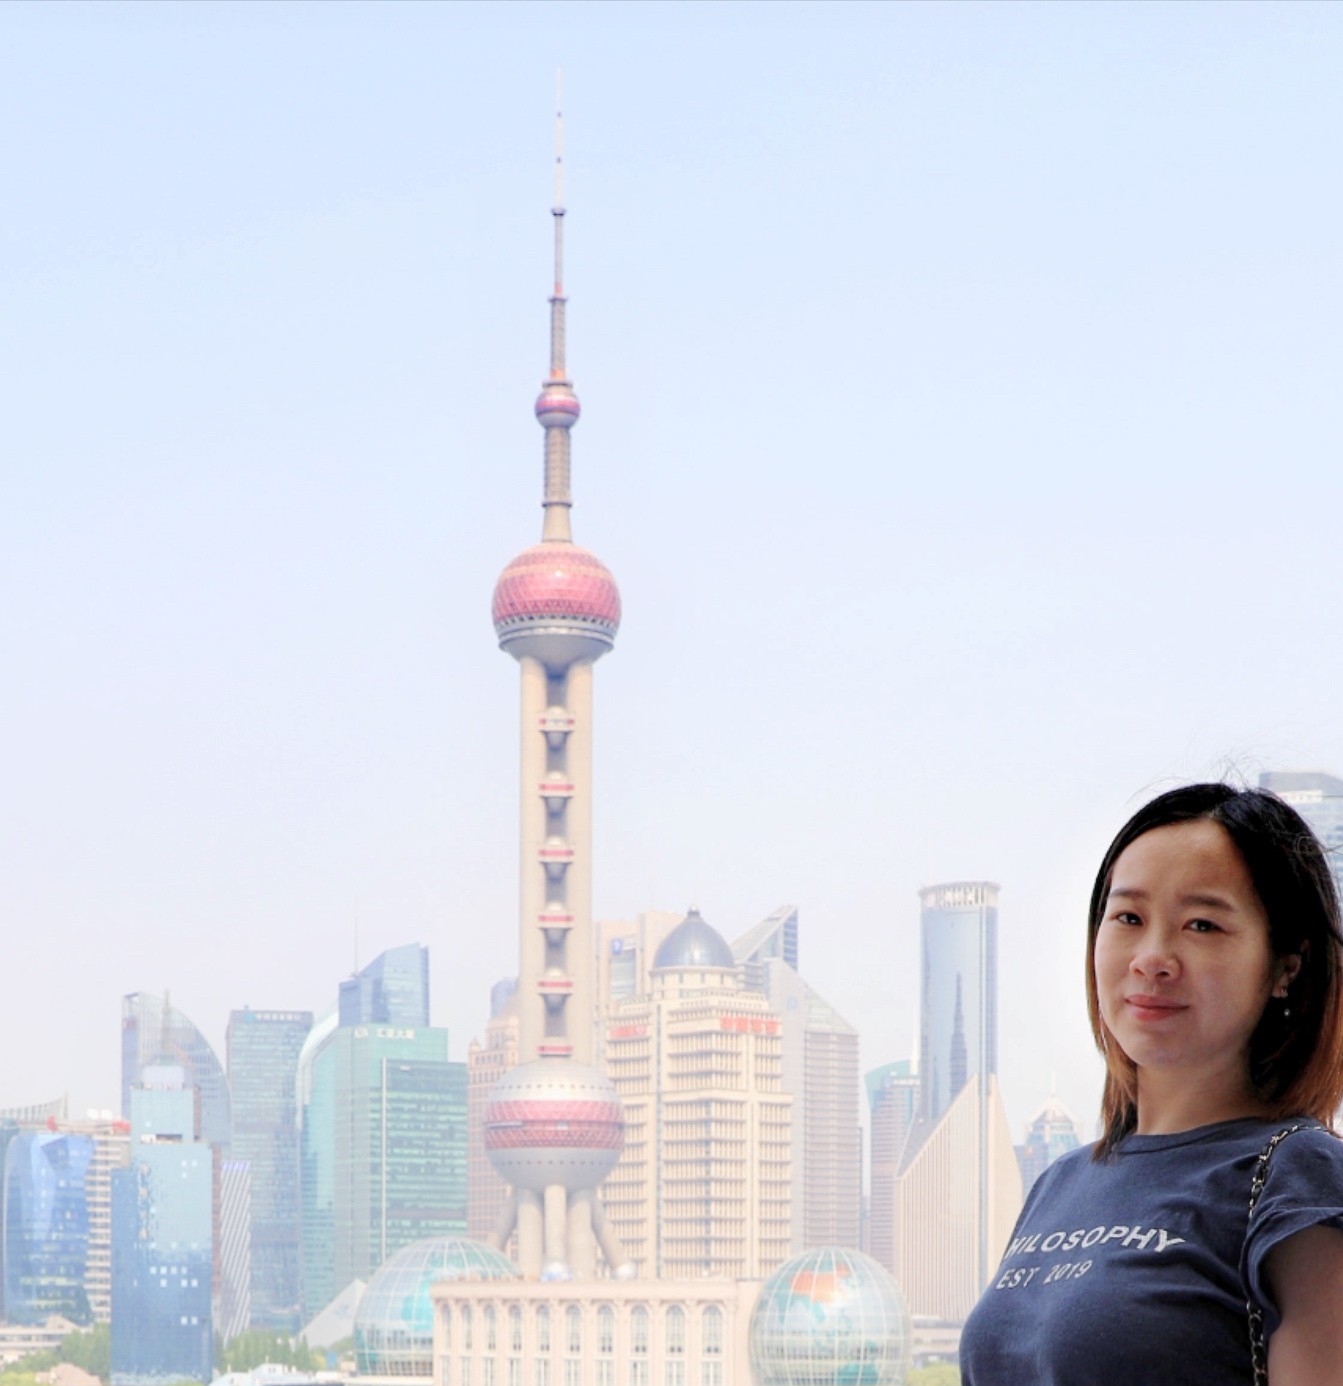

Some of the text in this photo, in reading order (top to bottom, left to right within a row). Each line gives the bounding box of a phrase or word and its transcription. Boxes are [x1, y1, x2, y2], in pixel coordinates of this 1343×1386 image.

[1004, 1225, 1186, 1259] HILOSOPHY
[996, 1260, 1093, 1290] EST 2019
